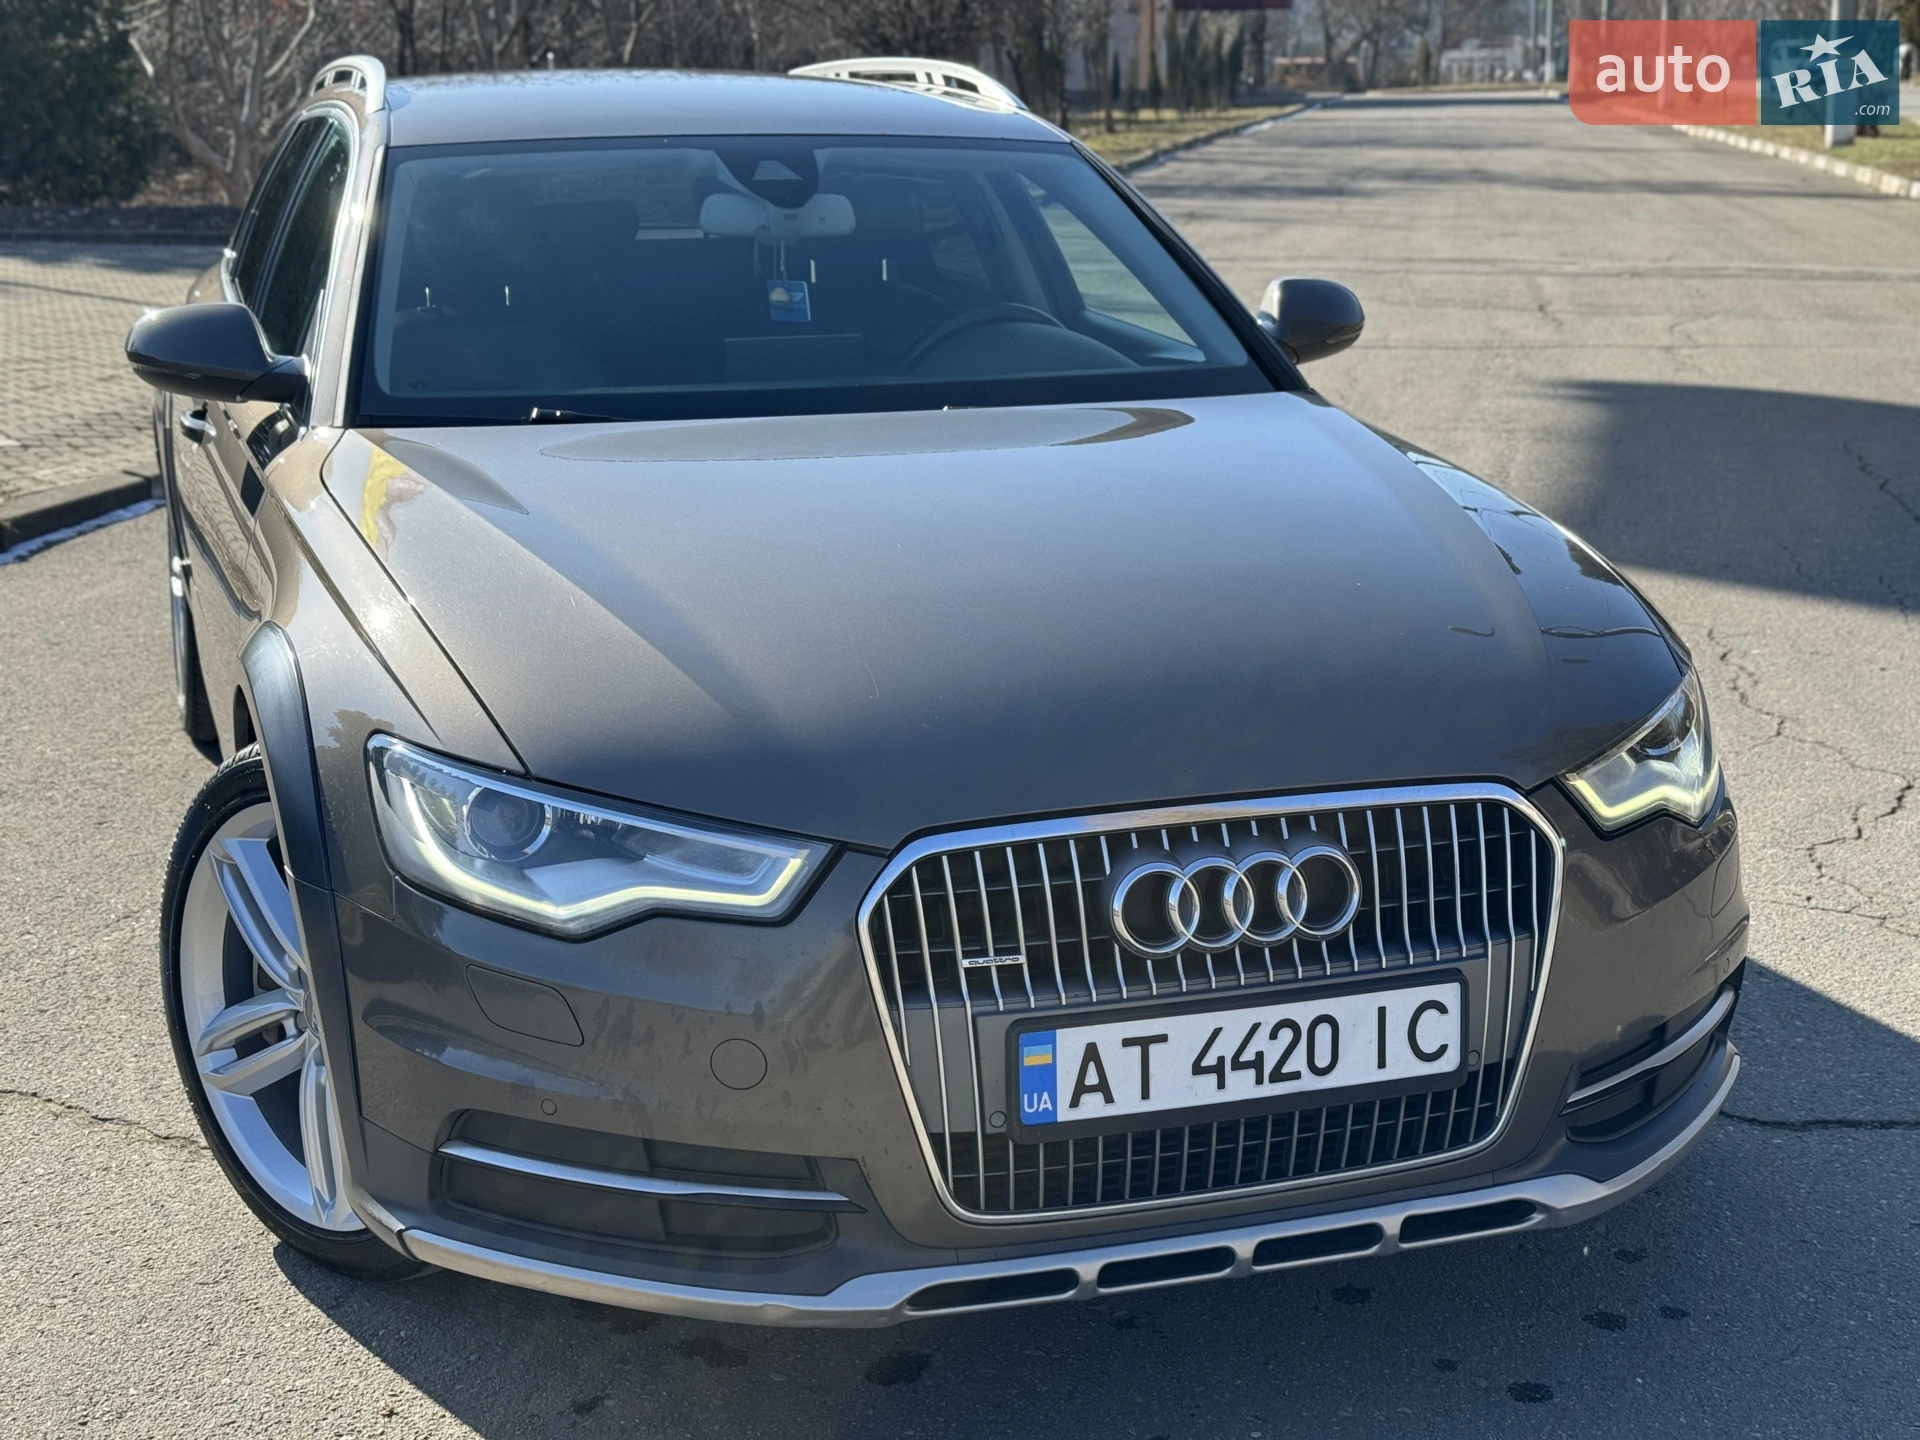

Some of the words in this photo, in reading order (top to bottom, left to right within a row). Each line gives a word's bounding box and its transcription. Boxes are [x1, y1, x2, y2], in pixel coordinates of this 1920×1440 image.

[968, 956, 1020, 967] quattro
[1068, 1033, 1169, 1109] AT
[1191, 1013, 1341, 1091] 4420
[1376, 999, 1450, 1070] IC
[1022, 1091, 1054, 1114] UA
